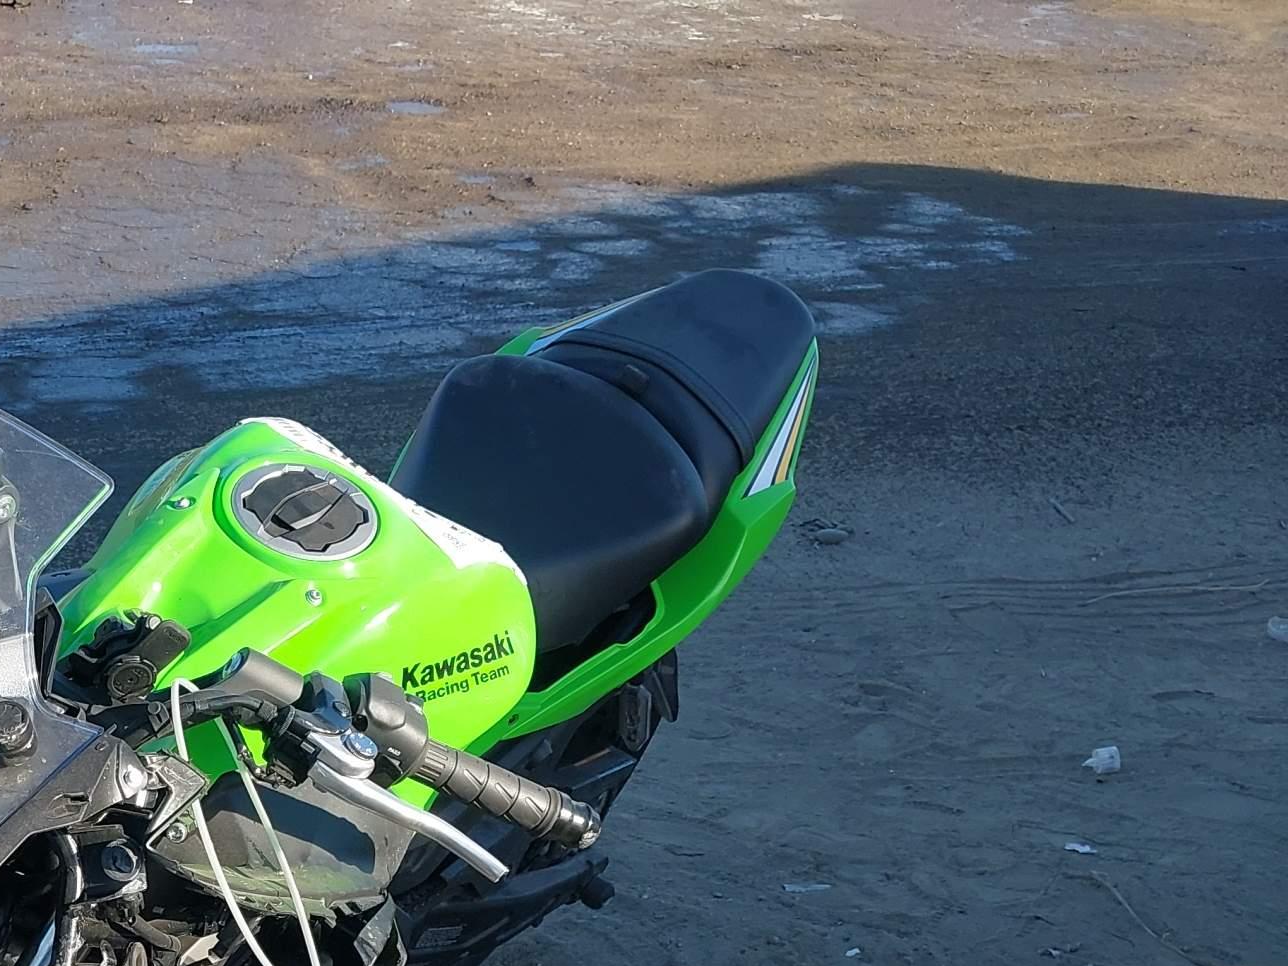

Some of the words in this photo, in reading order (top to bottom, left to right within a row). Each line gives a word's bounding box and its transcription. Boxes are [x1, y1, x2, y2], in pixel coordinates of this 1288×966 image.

[401, 630, 514, 690] Kawasaki
[415, 677, 470, 702] Racing
[471, 665, 510, 686] Team
